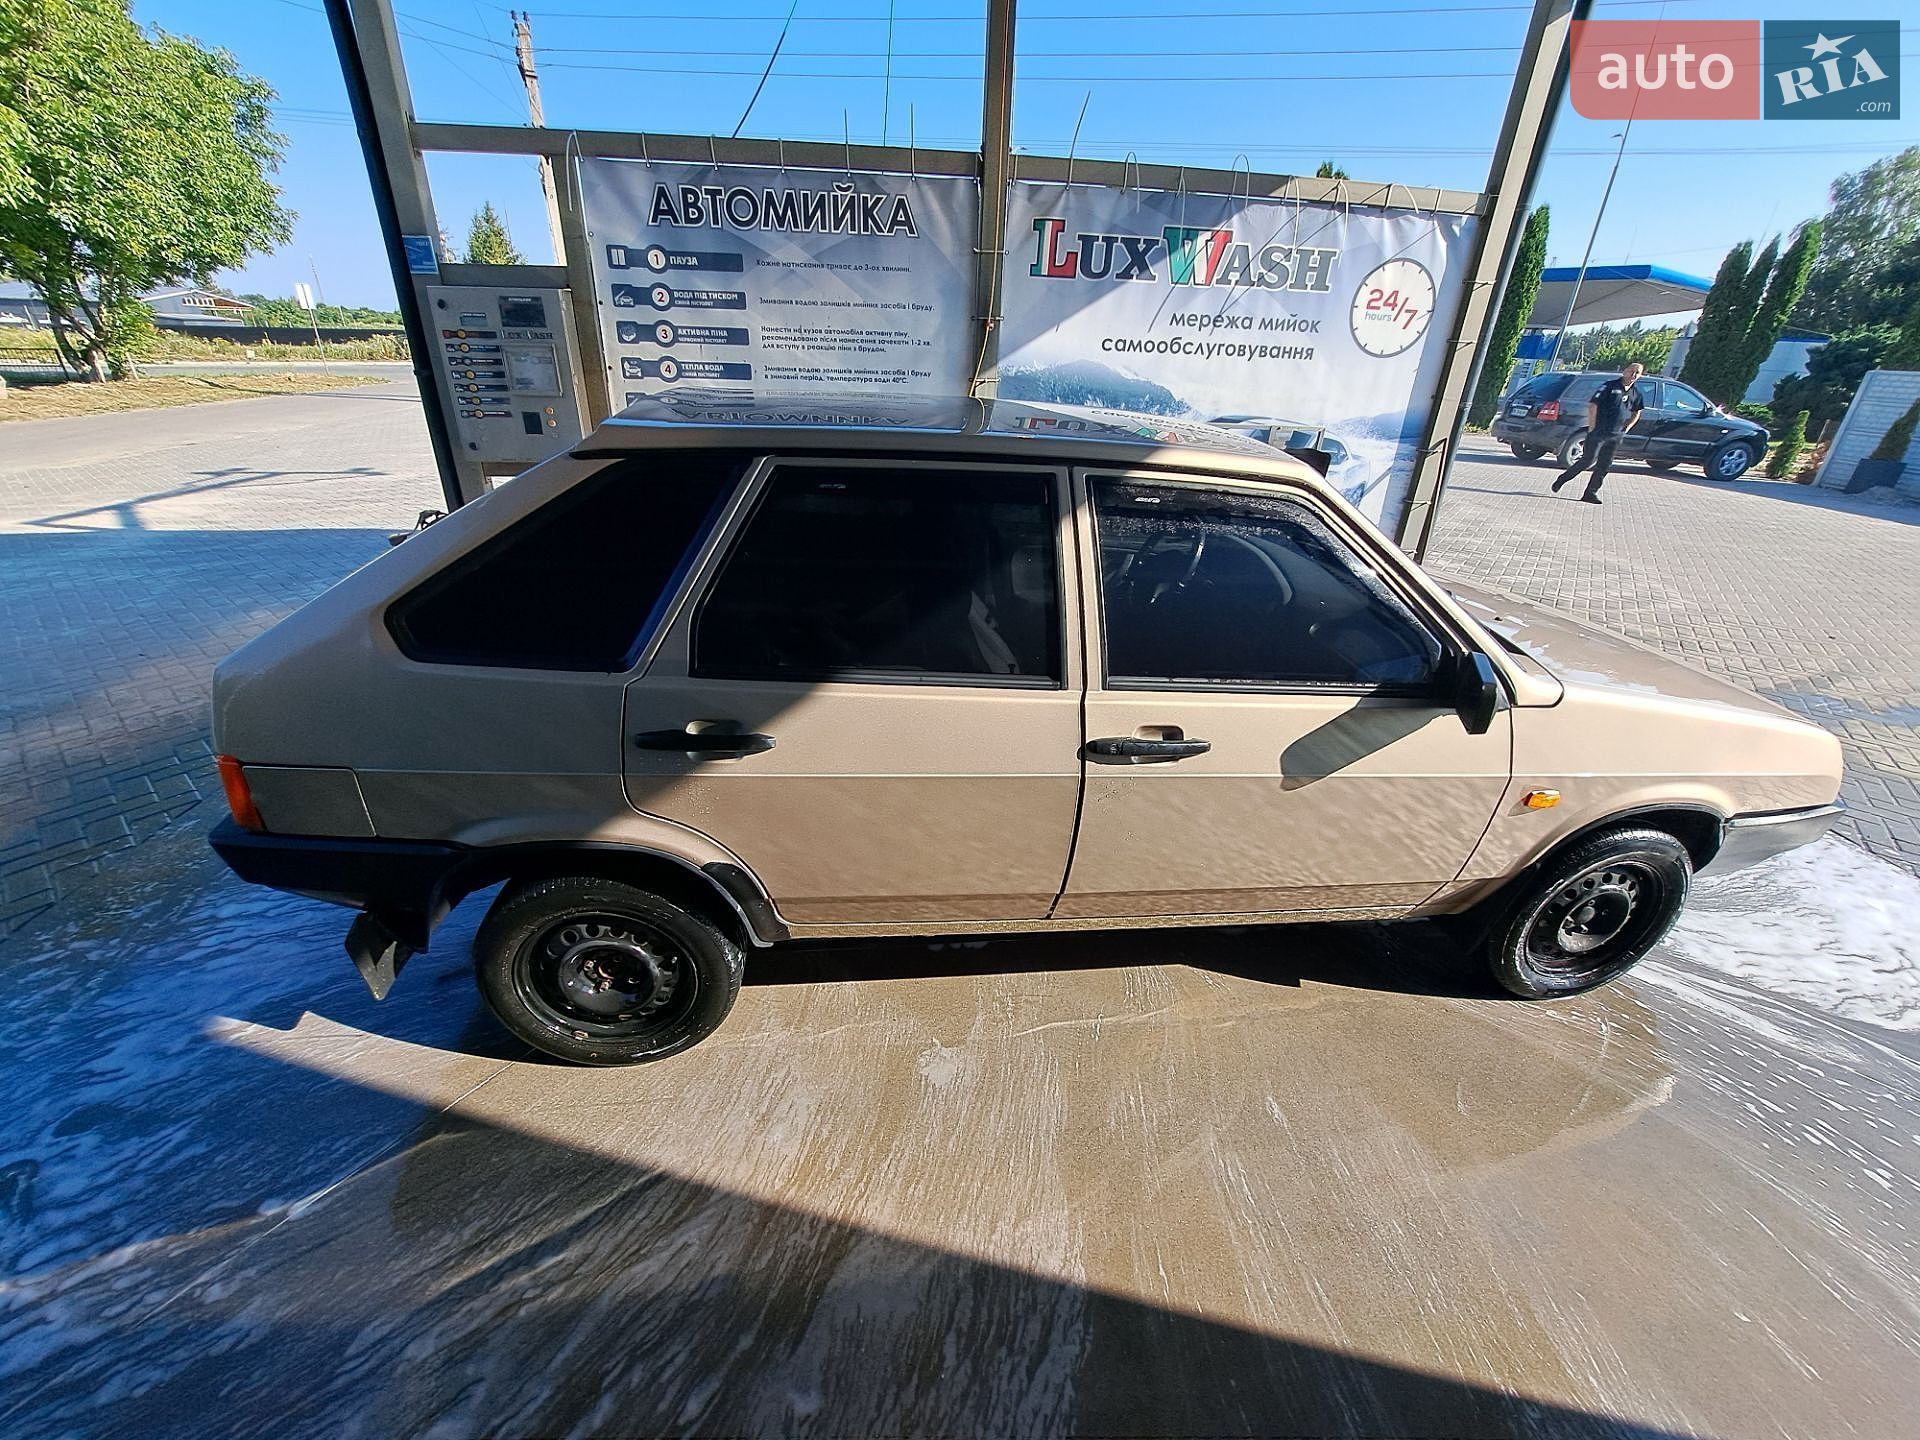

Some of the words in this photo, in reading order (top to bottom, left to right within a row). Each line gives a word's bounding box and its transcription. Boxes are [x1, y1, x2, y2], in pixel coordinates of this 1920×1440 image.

[648, 182, 919, 238] АВТОМИЙКА
[653, 254, 660, 265] 1
[669, 255, 698, 266] ПАУЗА
[656, 291, 665, 303] 2
[673, 291, 693, 299] ВОДА
[694, 292, 708, 300] ПІД
[708, 292, 738, 300] ТИСКОМ
[1366, 288, 1418, 330] 24/7
[1364, 311, 1392, 321] hours
[1169, 312, 1253, 331] мережа
[1257, 313, 1321, 333] мийок
[661, 328, 669, 339] 3
[711, 329, 728, 337] ПІНА
[761, 325, 791, 333] Нанести
[825, 328, 864, 336] автомобіля
[1101, 336, 1315, 361] самообслуговування
[664, 364, 673, 375] 4
[681, 363, 703, 371] ТЕПЛА
